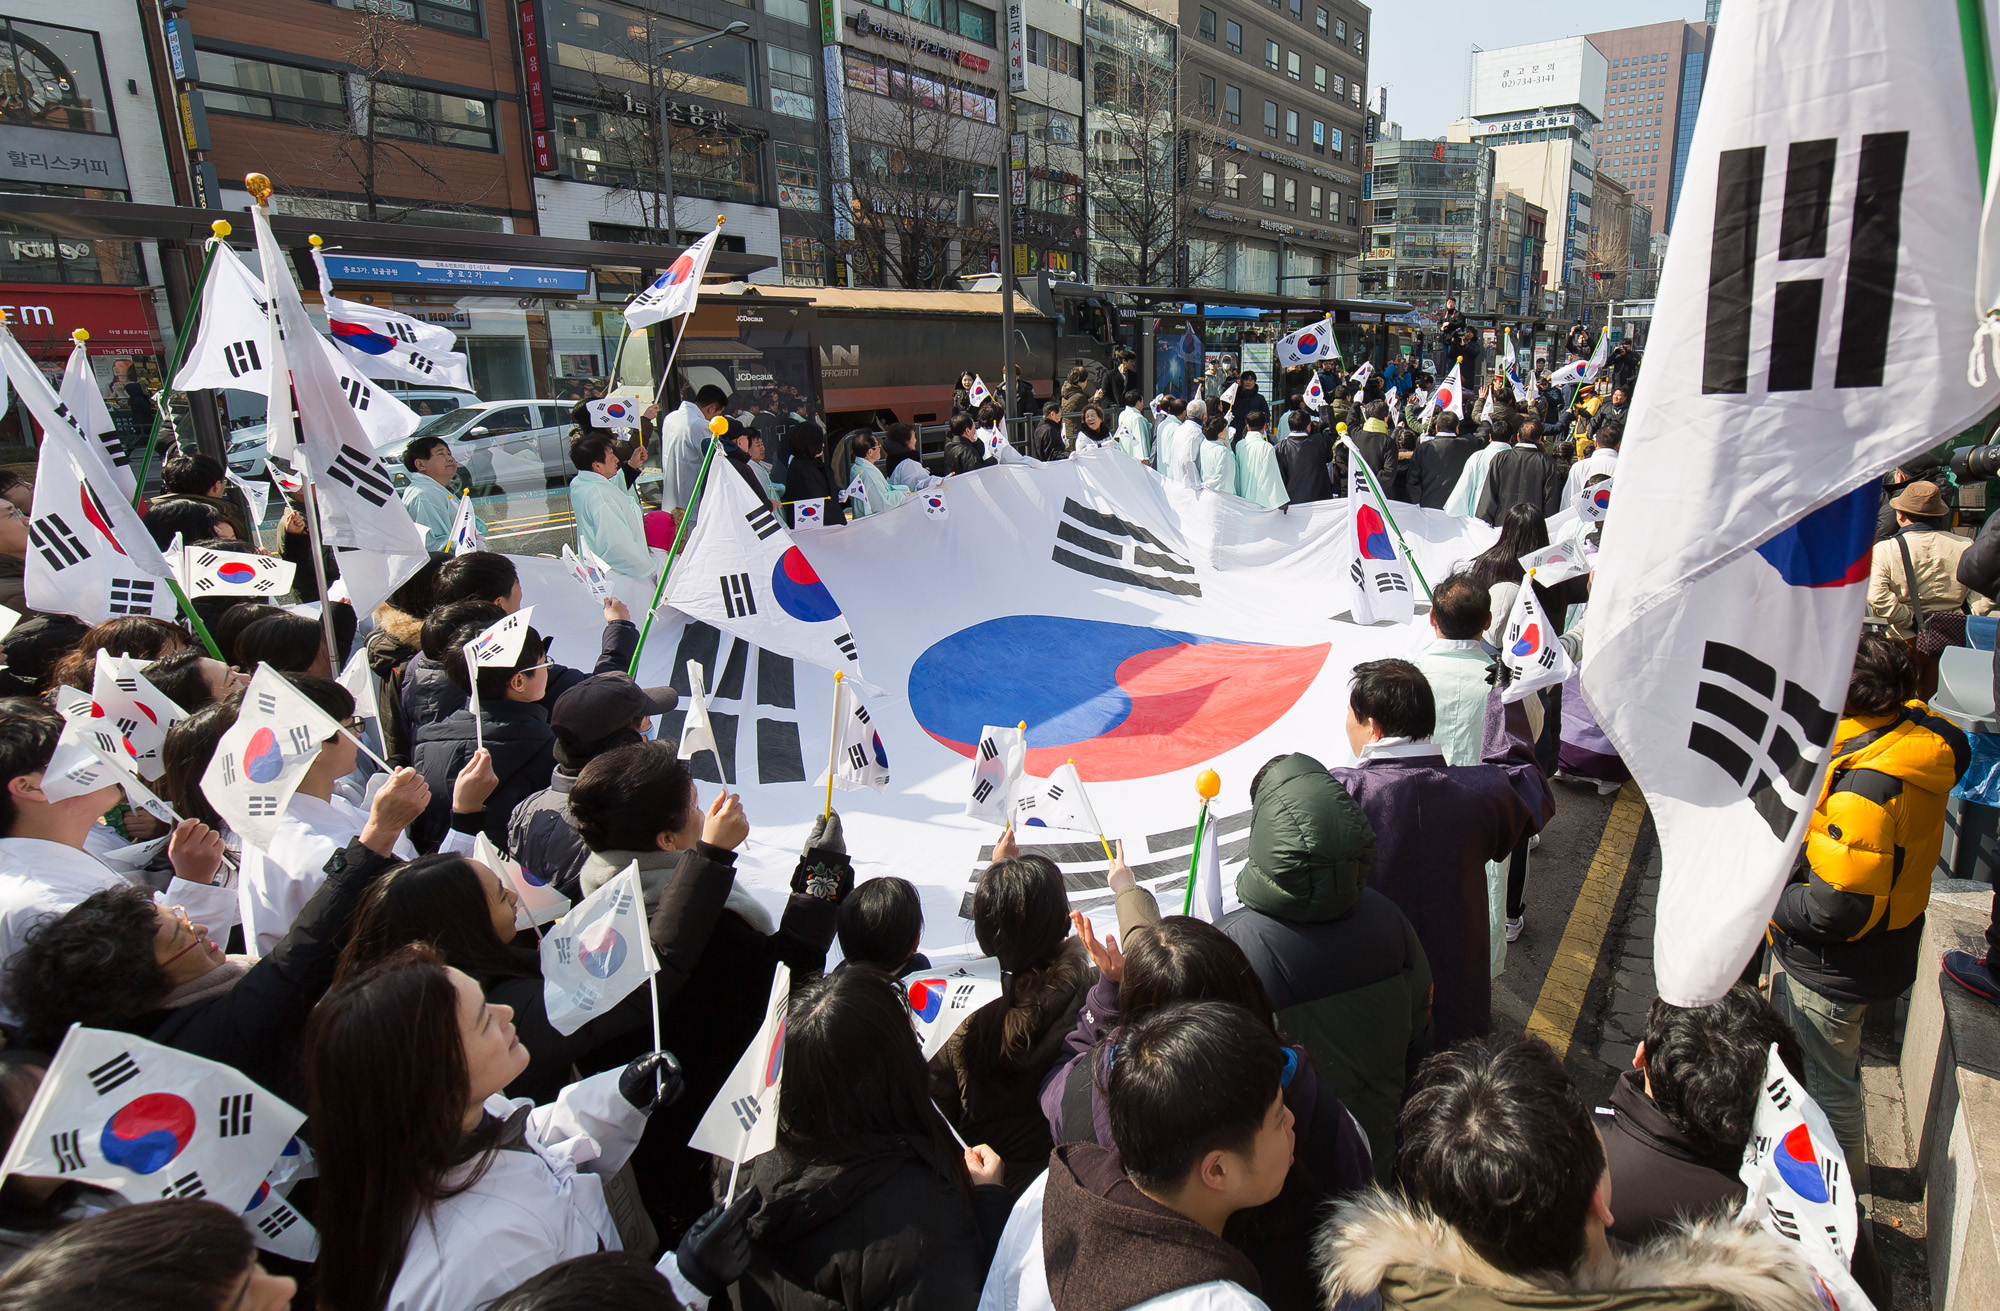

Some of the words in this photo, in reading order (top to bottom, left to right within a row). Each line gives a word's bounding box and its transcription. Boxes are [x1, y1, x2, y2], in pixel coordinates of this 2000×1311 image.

[522, 12, 533, 23] 1ST
[526, 33, 540, 97] 조용관
[537, 135, 548, 167] 헤어
[7, 150, 109, 176] 할리스커피
[1014, 171, 1024, 198] 사진
[1368, 248, 1393, 258] 보청기
[446, 269, 483, 279] 종로2가
[428, 312, 465, 322] HONG
[736, 315, 764, 323] JCDecaux
[736, 373, 773, 382] JCDecaux
[821, 369, 852, 378] EFFICIENT
